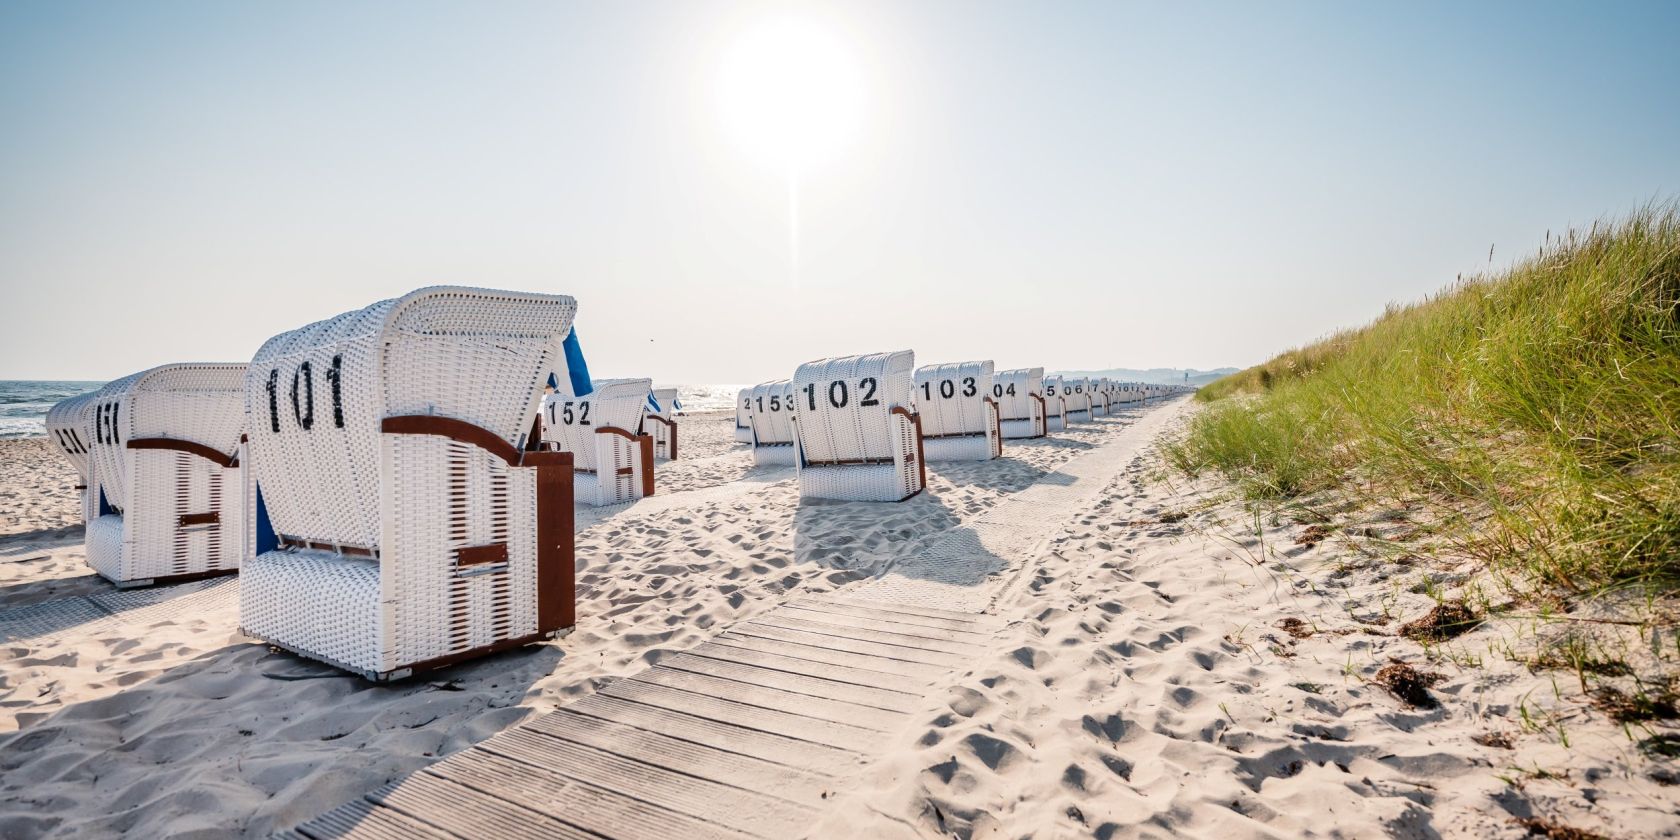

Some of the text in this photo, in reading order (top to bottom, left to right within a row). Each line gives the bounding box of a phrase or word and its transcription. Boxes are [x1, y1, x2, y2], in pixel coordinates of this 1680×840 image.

[266, 354, 344, 432] 101
[803, 377, 879, 411] 102
[920, 377, 977, 401] 103
[993, 382, 1016, 398] 04
[1064, 385, 1083, 396] 06
[548, 401, 591, 426] 152
[755, 394, 794, 413] 153
